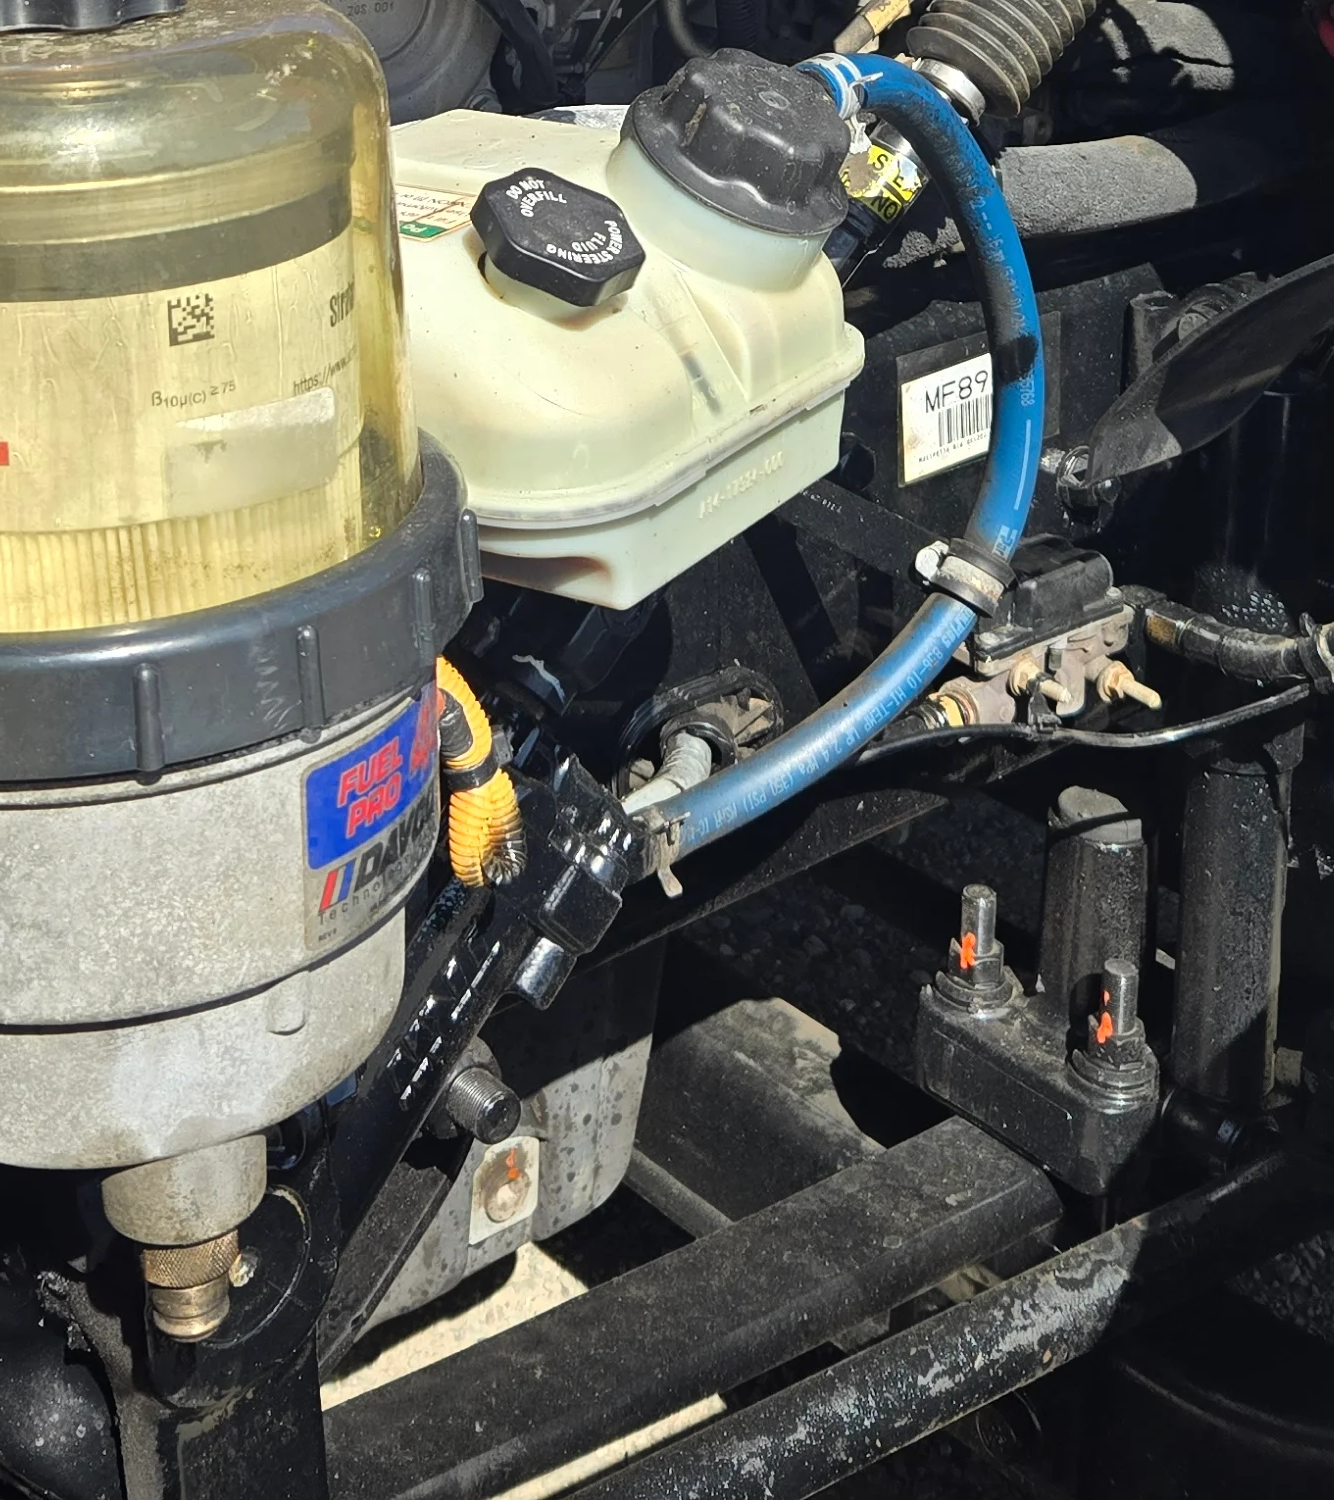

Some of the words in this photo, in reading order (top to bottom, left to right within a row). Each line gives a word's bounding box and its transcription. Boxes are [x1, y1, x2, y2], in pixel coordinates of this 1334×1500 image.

[505, 185, 523, 200] DO
[522, 179, 546, 192] NOT
[521, 190, 567, 218] OVERFILL
[545, 243, 616, 265] STEERING
[571, 231, 607, 253] FLUID
[604, 219, 624, 255] POWER
[925, 370, 989, 414] MF89
[863, 684, 915, 734] HI-TEMP
[337, 735, 404, 808] FUEL
[345, 771, 403, 840] PRO
